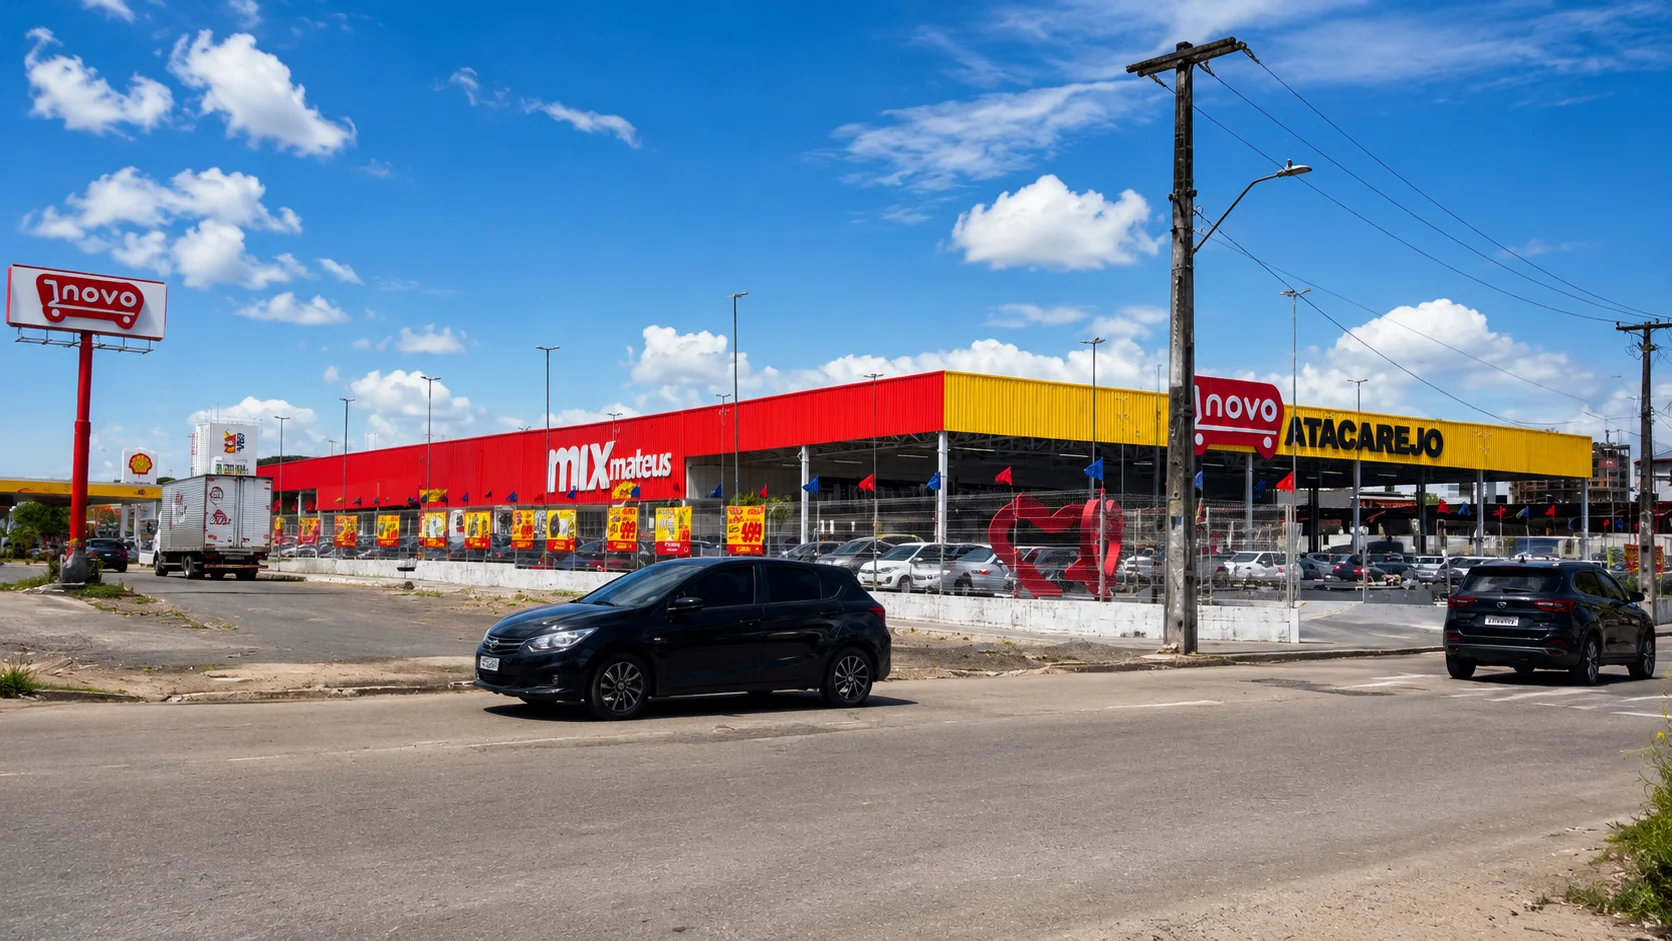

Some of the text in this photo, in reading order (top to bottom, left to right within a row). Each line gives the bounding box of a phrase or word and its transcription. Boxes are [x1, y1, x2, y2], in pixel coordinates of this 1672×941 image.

[62, 284, 137, 308] novo
[1205, 393, 1278, 423] novo
[1284, 416, 1444, 458] ATACAREJO
[610, 449, 672, 481] mateus
